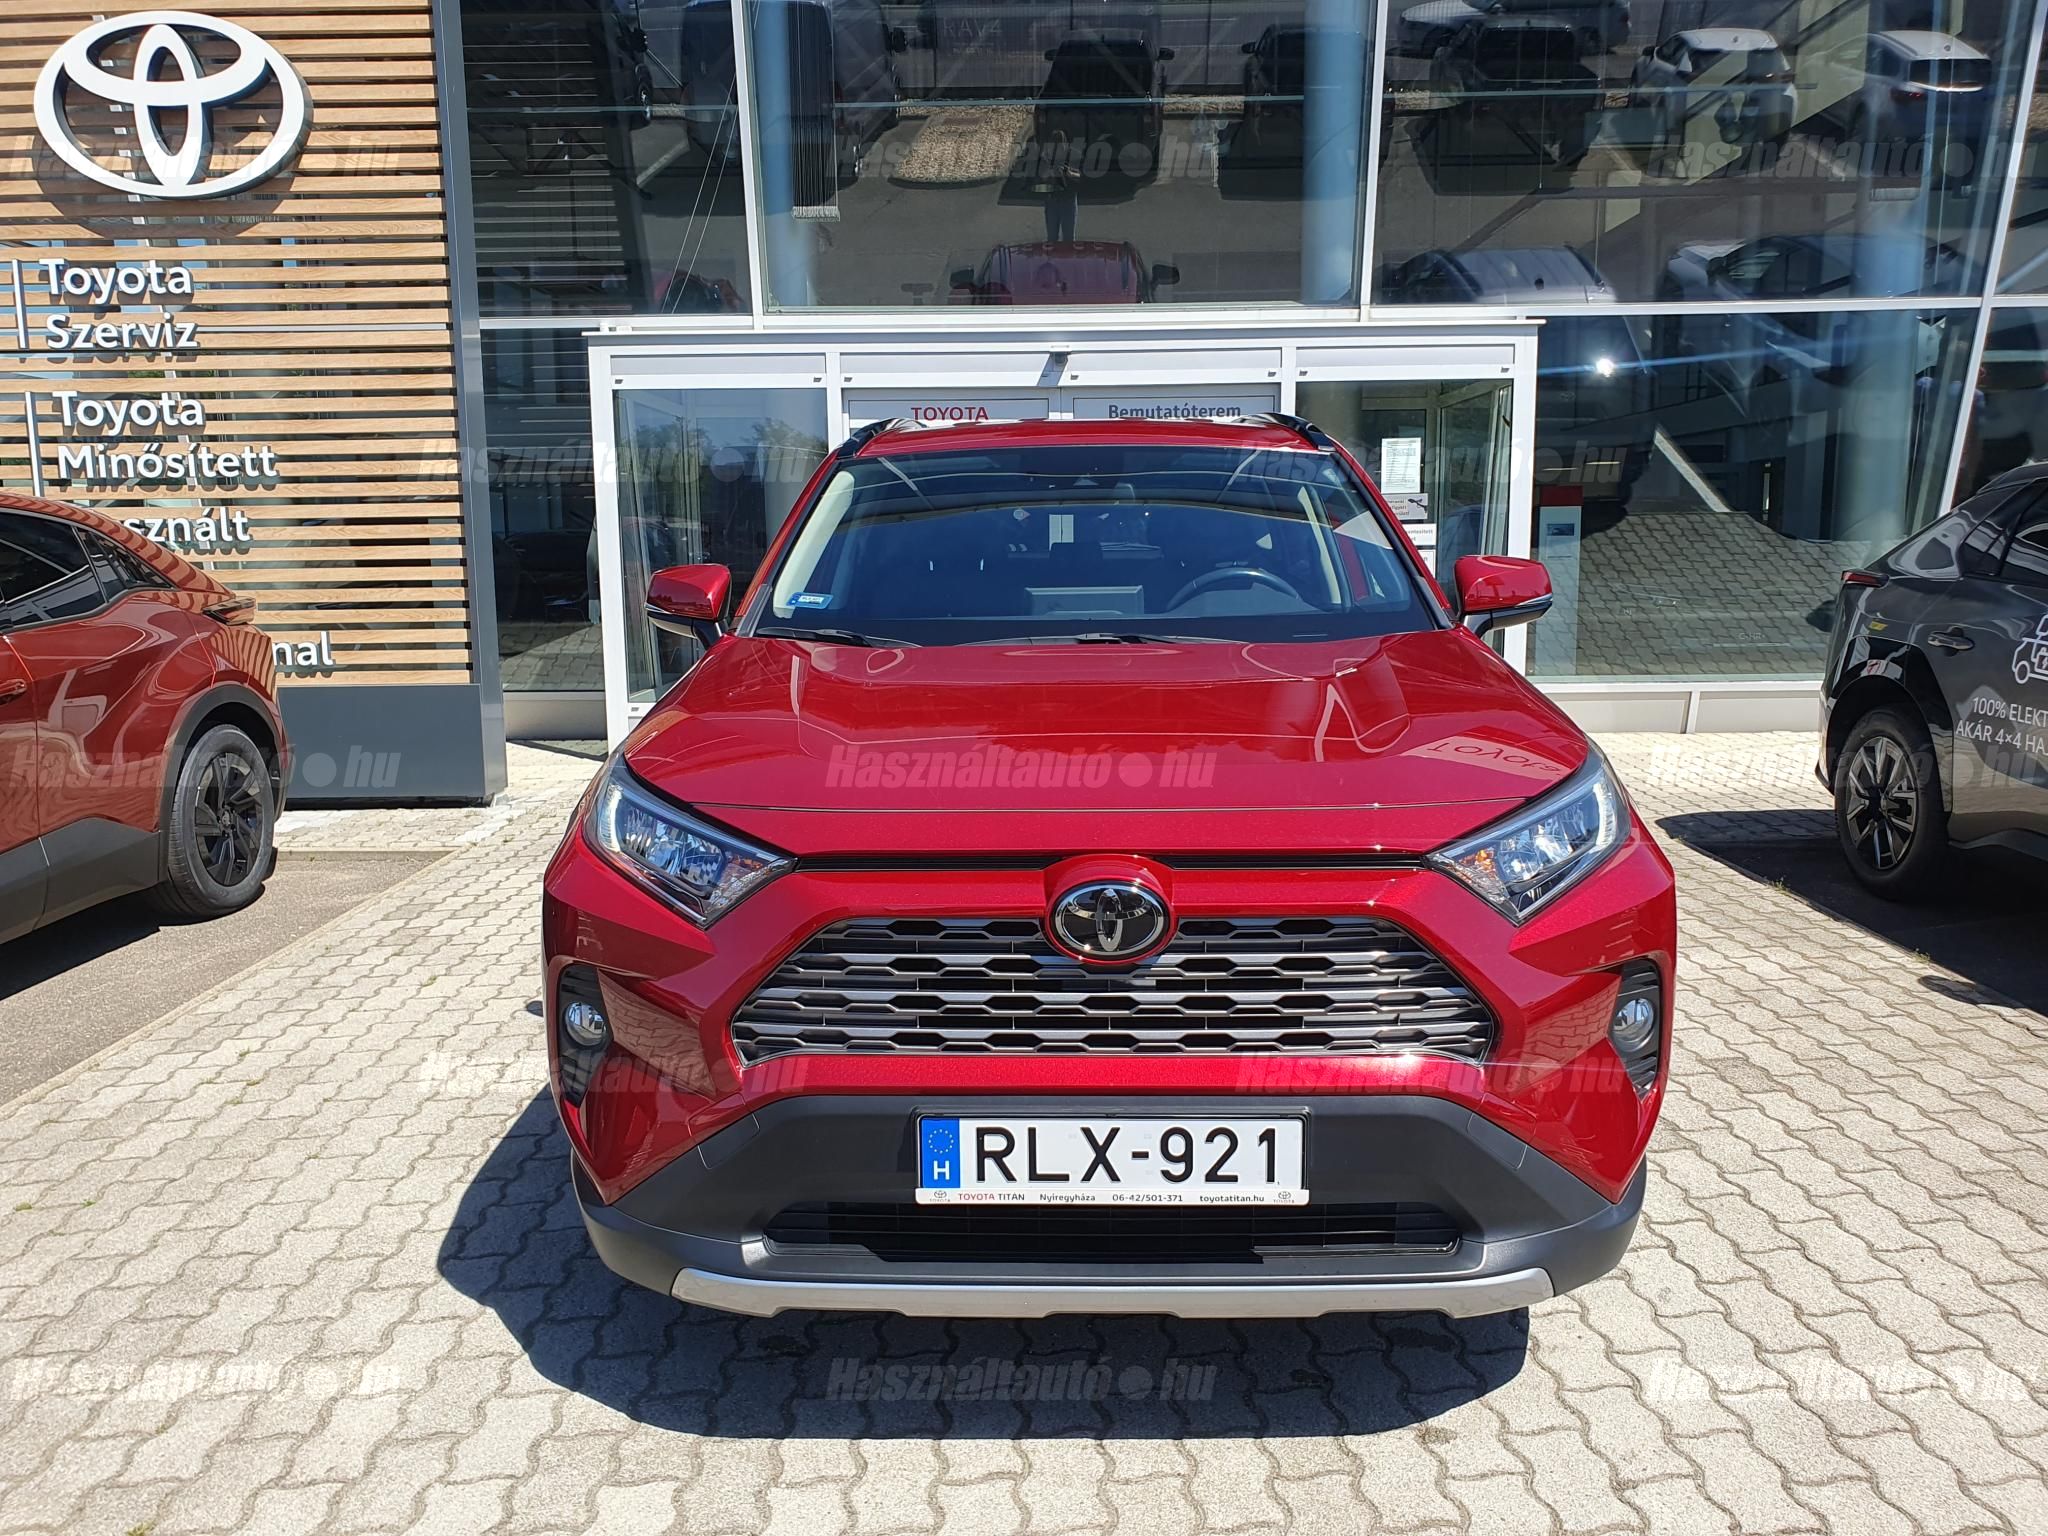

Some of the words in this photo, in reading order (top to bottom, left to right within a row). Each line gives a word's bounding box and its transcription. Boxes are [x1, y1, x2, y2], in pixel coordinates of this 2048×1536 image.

[39, 258, 192, 304] Toyota
[46, 312, 198, 349] Szerviz
[52, 390, 204, 436] Toyota
[911, 406, 989, 421] TOYOTA
[1108, 403, 1241, 419] Bemutatóterem
[58, 443, 278, 479] Minősített
[123, 507, 250, 542] sznált
[1972, 697, 2006, 719] 100%
[1956, 719, 1993, 743] AKÁR
[976, 1126, 1276, 1183] RLX-921
[933, 1160, 950, 1180] H
[958, 1192, 995, 1201] TOYOTA
[1039, 1192, 1096, 1203] Nyíregyháza
[1112, 1193, 1183, 1202] 06-42/501-371
[1199, 1193, 1265, 1204] toyotatitan.hu
